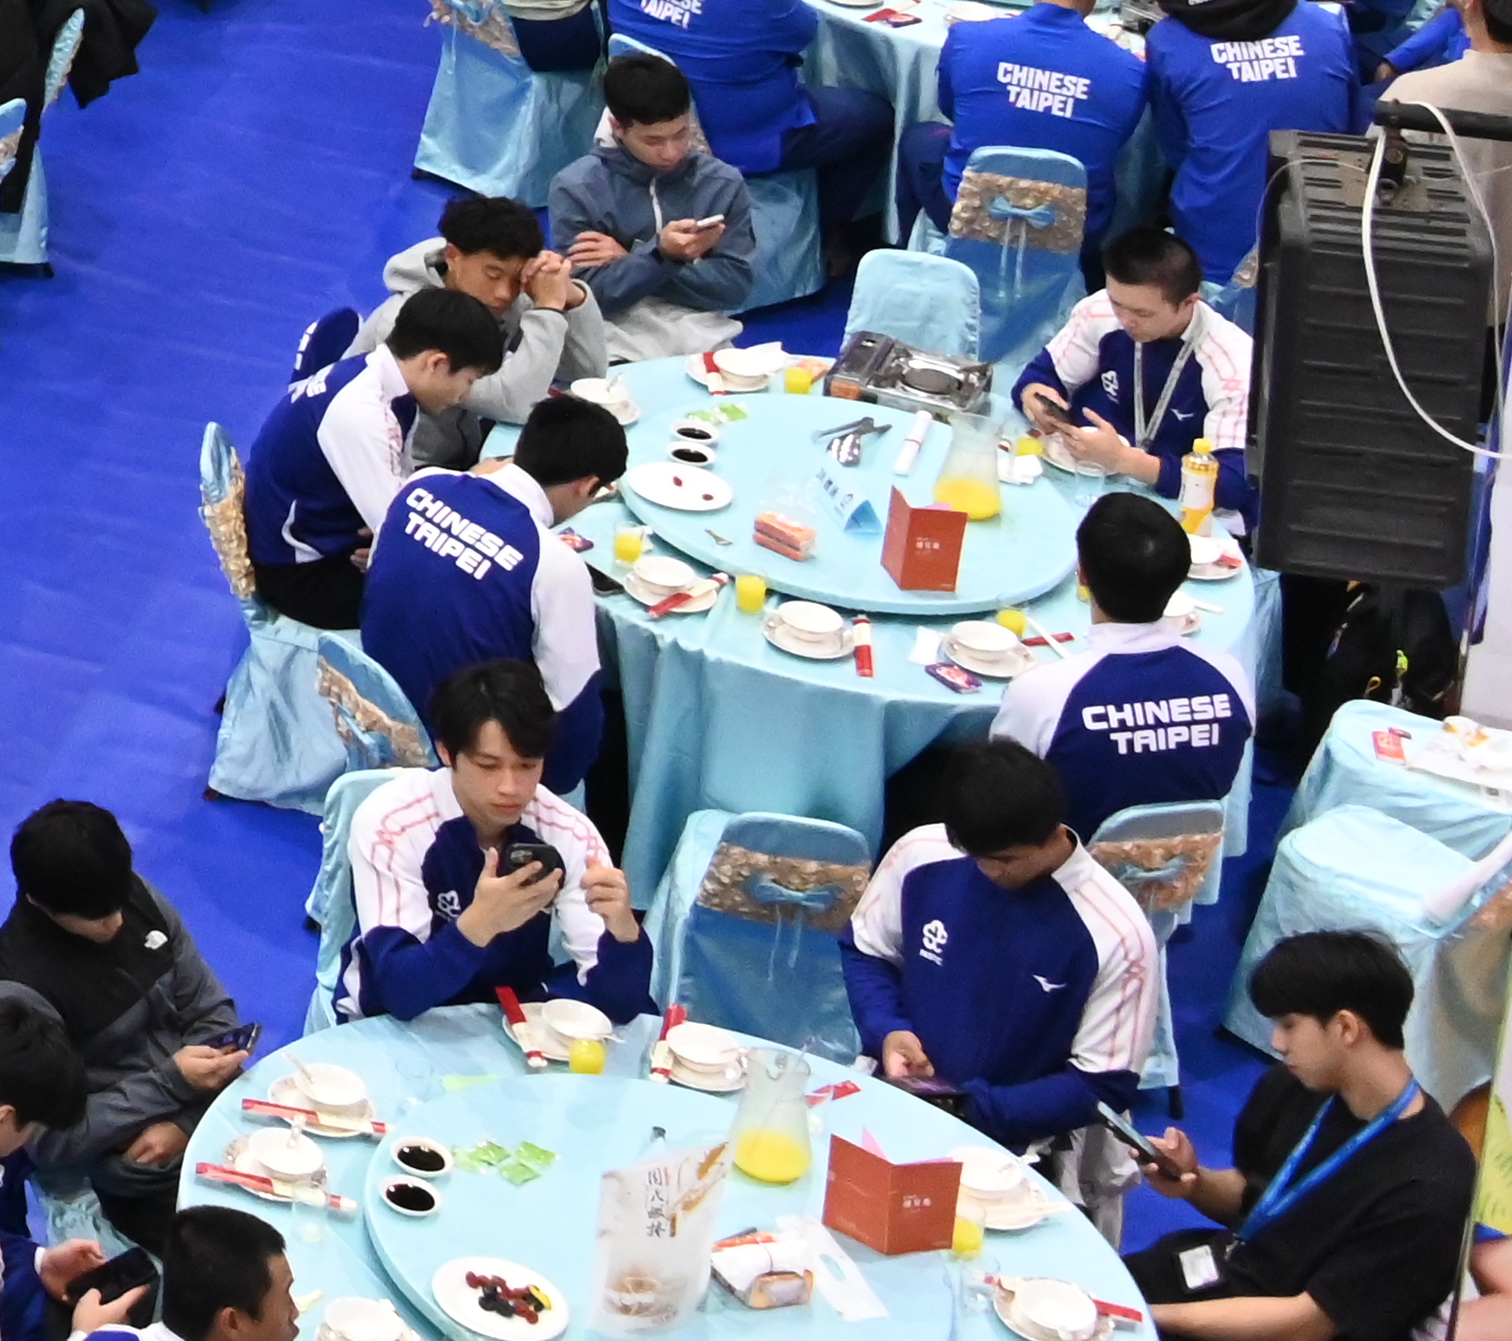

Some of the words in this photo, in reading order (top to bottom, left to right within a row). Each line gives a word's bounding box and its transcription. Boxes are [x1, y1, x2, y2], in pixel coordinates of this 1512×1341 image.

[1210, 35, 1305, 65] CHINESE
[996, 61, 1091, 101] CHINESE
[1227, 57, 1297, 83] TAIPEI
[1007, 83, 1074, 118] TAIPEI
[405, 487, 524, 554] CHINESE
[405, 511, 492, 580] TAIPEI
[1082, 692, 1232, 731] CHINESE
[1109, 722, 1221, 755] TAIPEI
